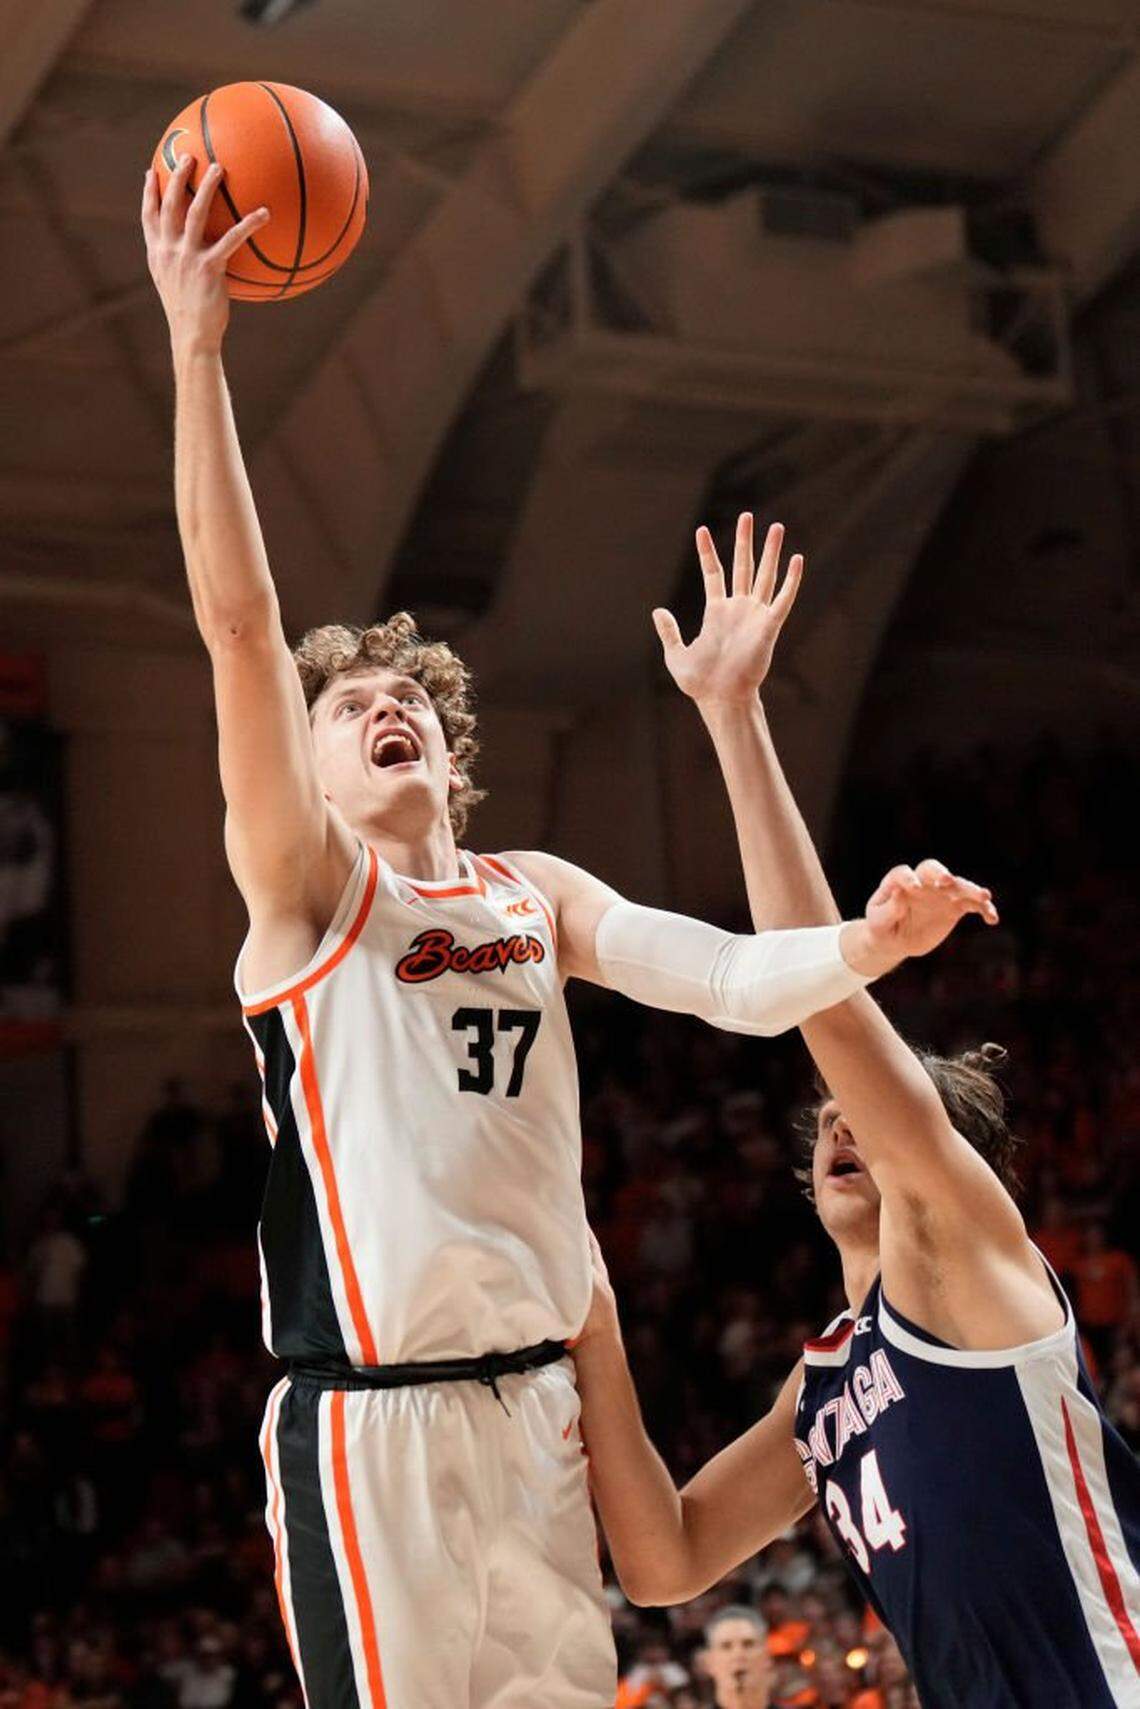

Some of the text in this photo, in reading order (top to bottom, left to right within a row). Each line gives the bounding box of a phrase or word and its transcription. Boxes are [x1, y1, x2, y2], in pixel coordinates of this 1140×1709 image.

[395, 929, 545, 983] Beaves
[452, 1007, 541, 1098] 37
[825, 1448, 906, 1576] 34
